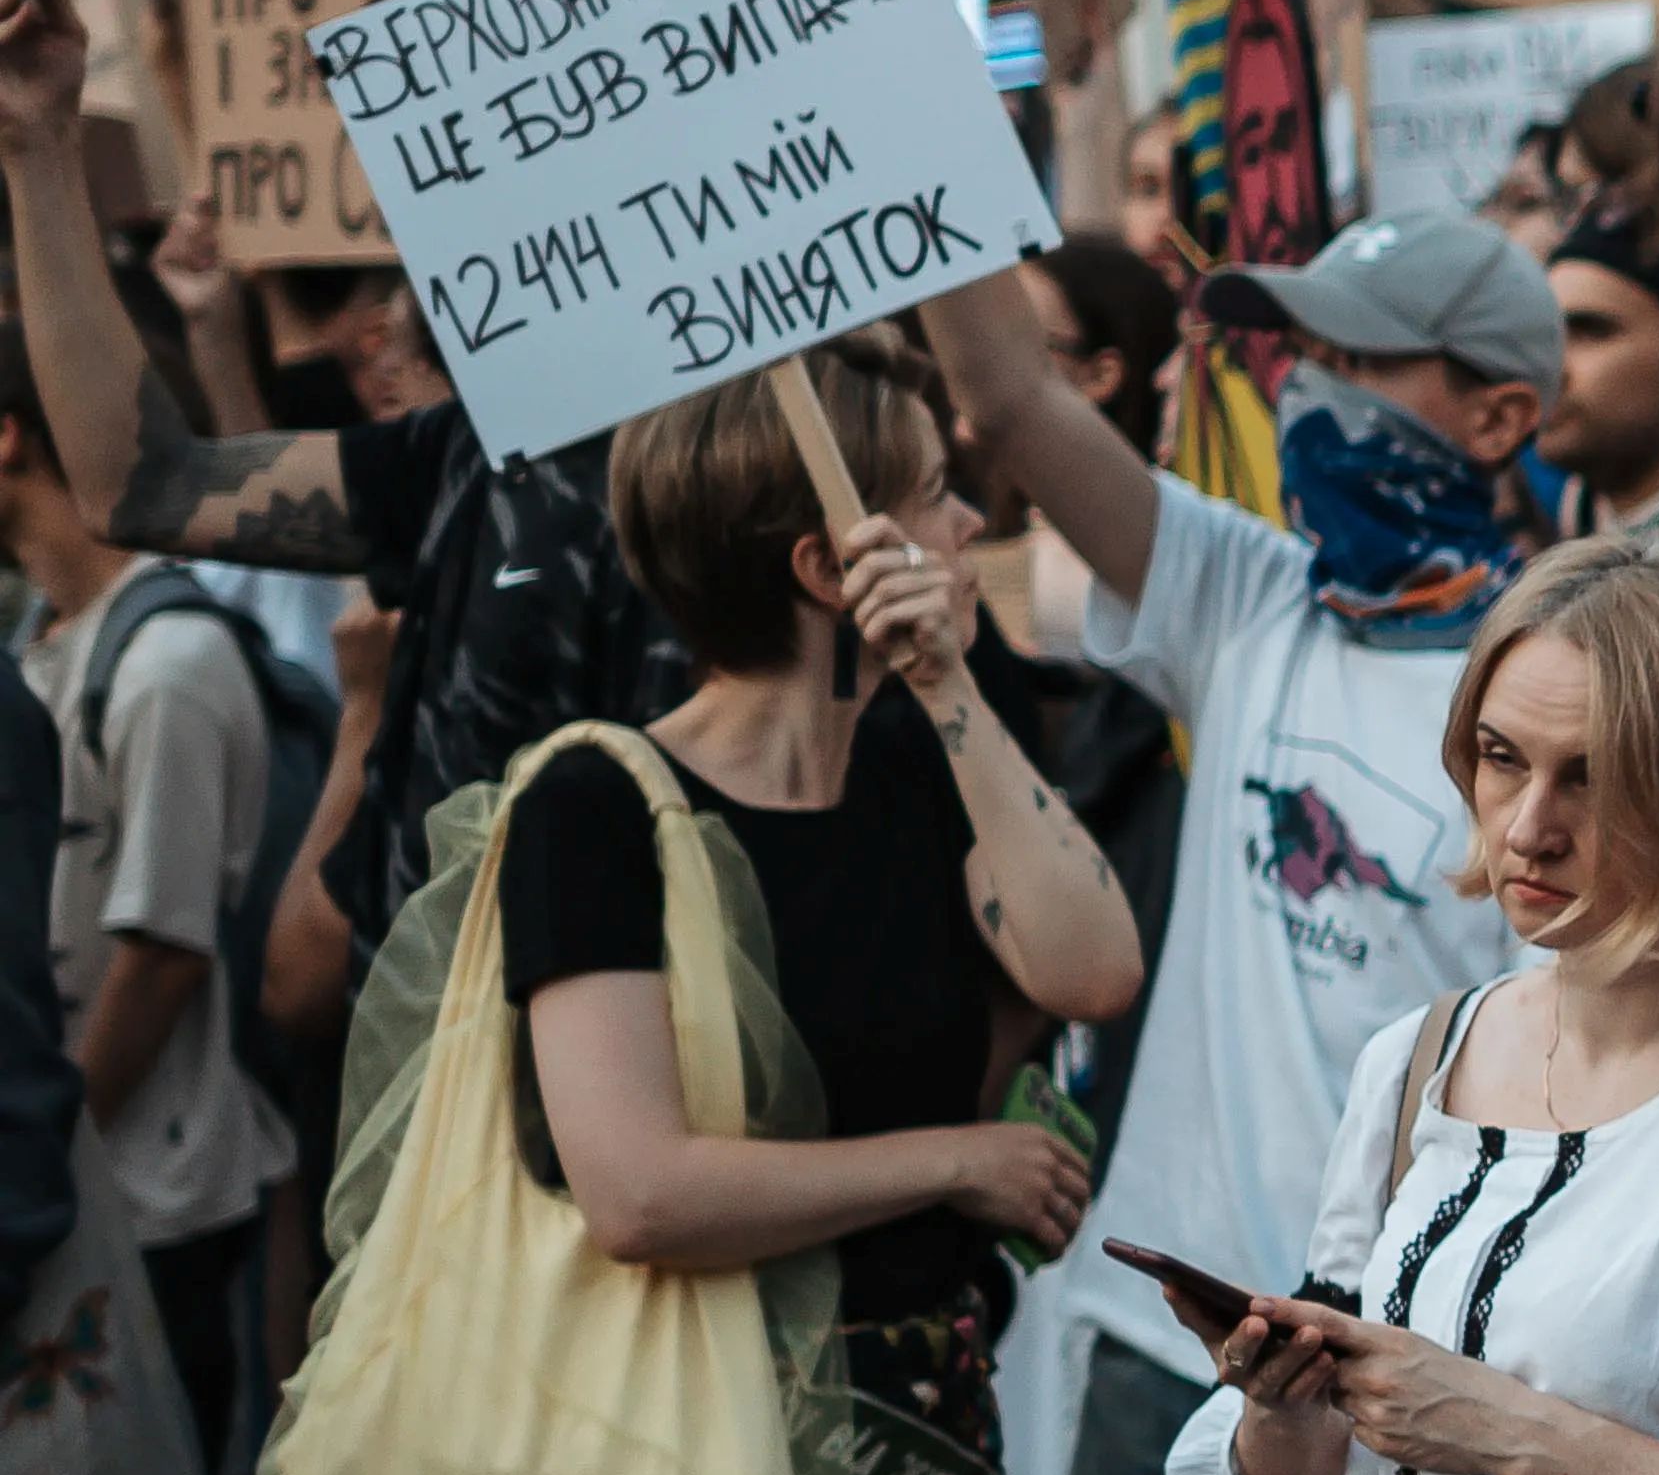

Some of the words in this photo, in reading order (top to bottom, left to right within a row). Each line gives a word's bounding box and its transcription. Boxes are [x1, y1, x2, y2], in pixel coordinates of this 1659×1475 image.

[210, 139, 308, 221] ПРО
[393, 109, 487, 195] ЦЕ
[484, 48, 650, 163] БУВ
[428, 211, 623, 356] 12414
[619, 177, 741, 262] ТИ
[740, 109, 857, 222] МІЙ
[645, 183, 985, 376] ВИНЯТОК
